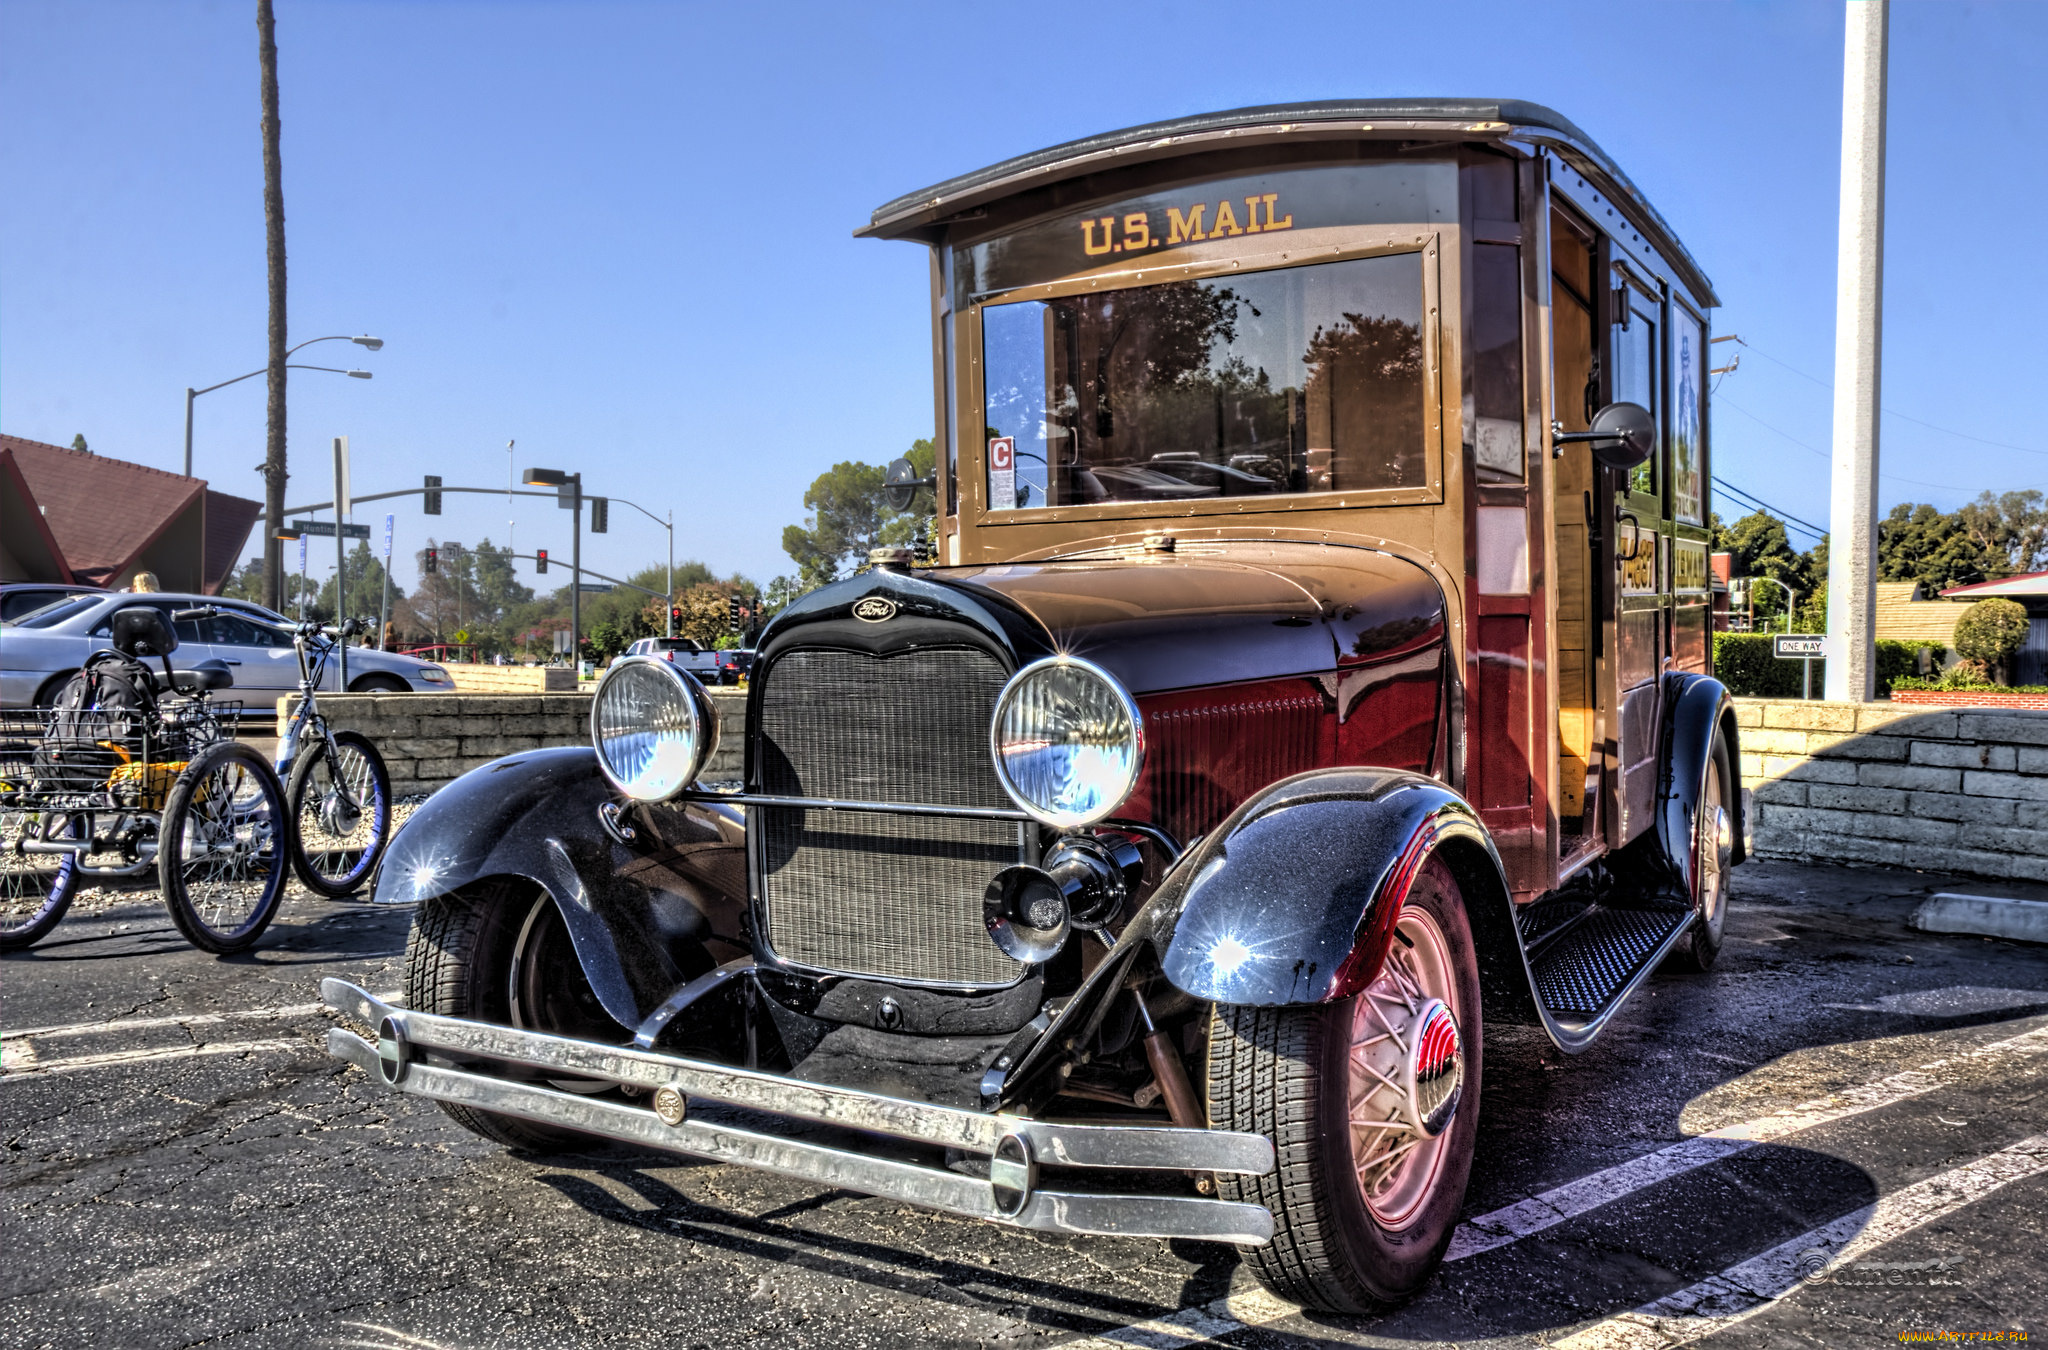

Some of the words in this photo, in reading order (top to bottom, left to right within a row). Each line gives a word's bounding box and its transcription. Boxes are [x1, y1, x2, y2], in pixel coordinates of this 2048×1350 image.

[1081, 212, 1159, 255] U.S.
[1166, 193, 1293, 245] MAIL
[993, 441, 1009, 467] C
[303, 523, 352, 536] Huntingon
[858, 601, 889, 616] Ford
[1782, 641, 1800, 651] ONE
[1802, 642, 1822, 651] WAY
